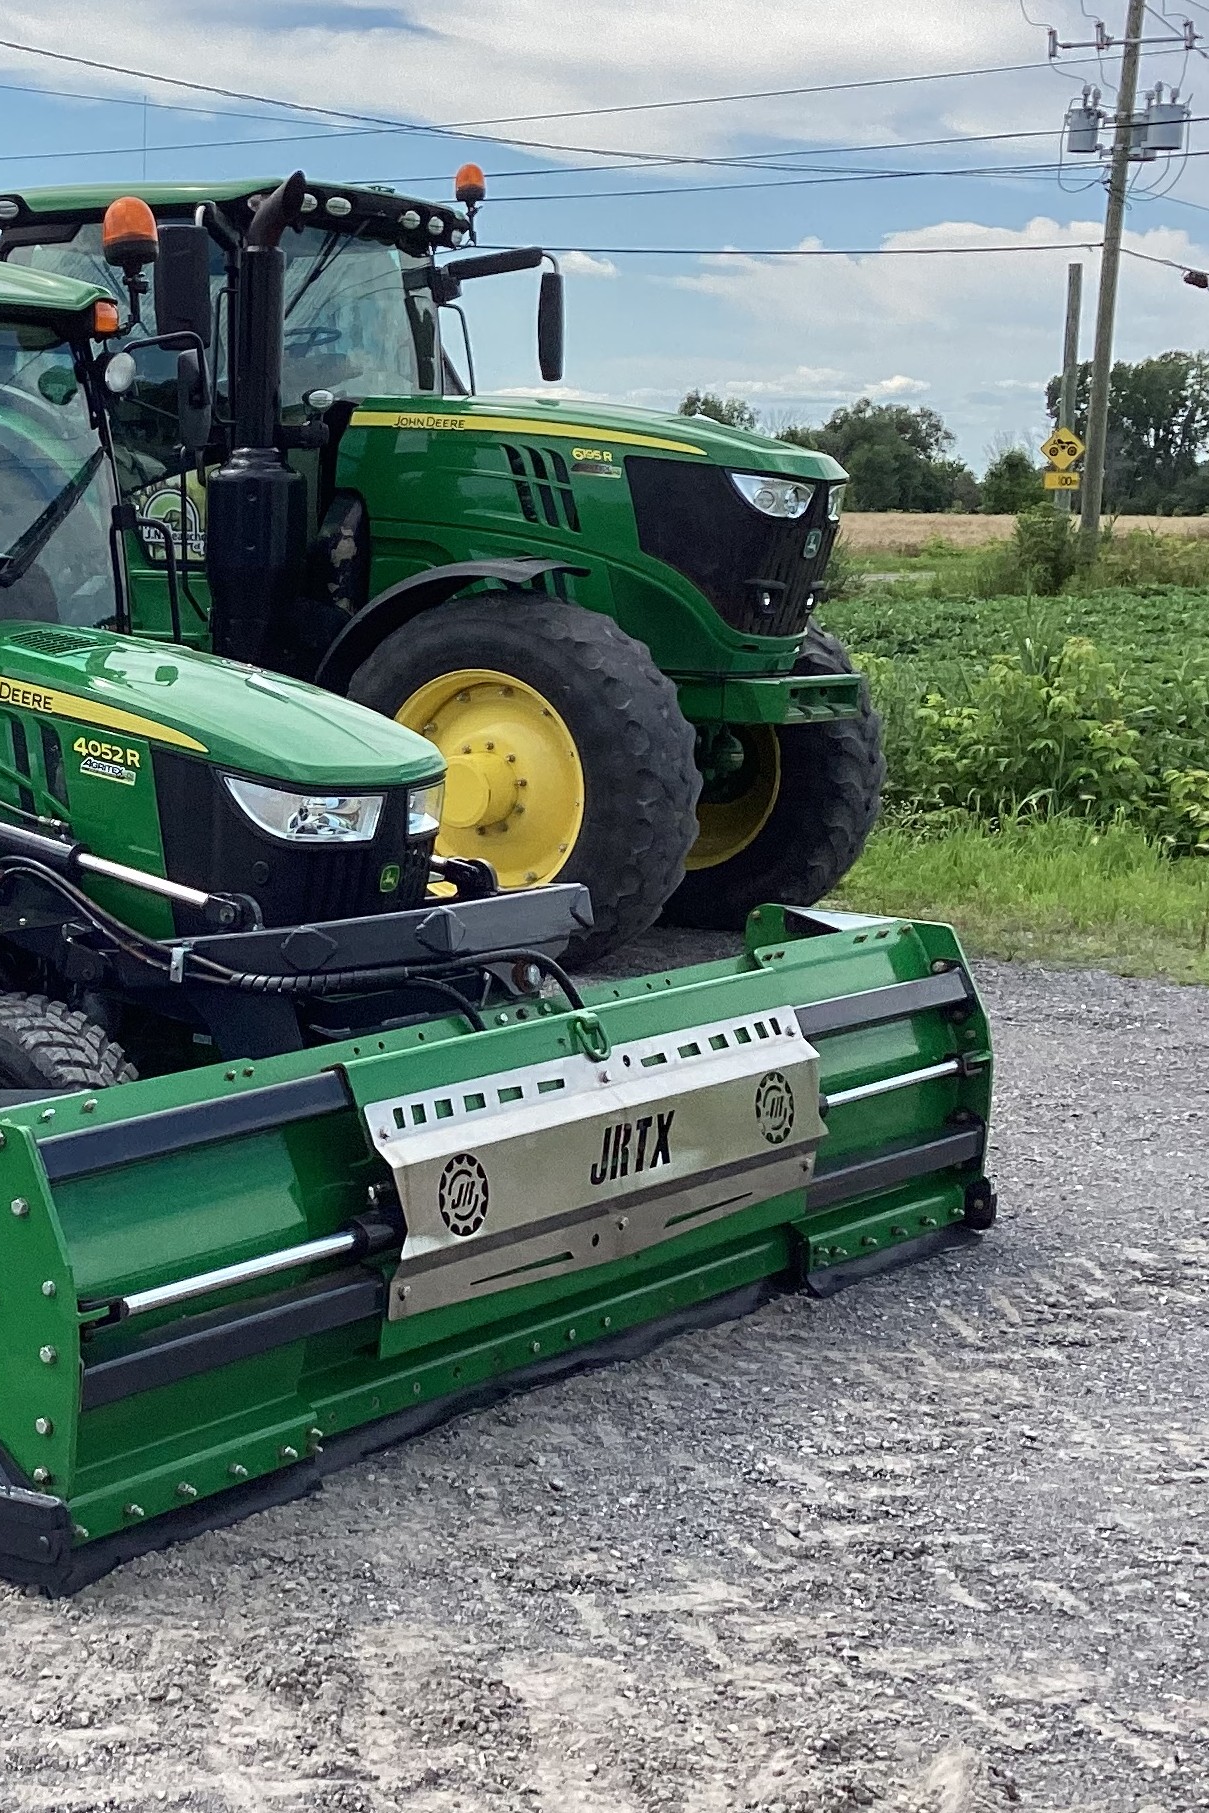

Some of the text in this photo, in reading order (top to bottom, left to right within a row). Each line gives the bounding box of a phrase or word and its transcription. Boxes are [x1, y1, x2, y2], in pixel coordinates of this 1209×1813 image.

[394, 416, 466, 429] JOHN DEERE
[0, 682, 54, 711] DEERE
[82, 758, 124, 776] AGRITEX
[590, 1109, 676, 1185] JRTX
